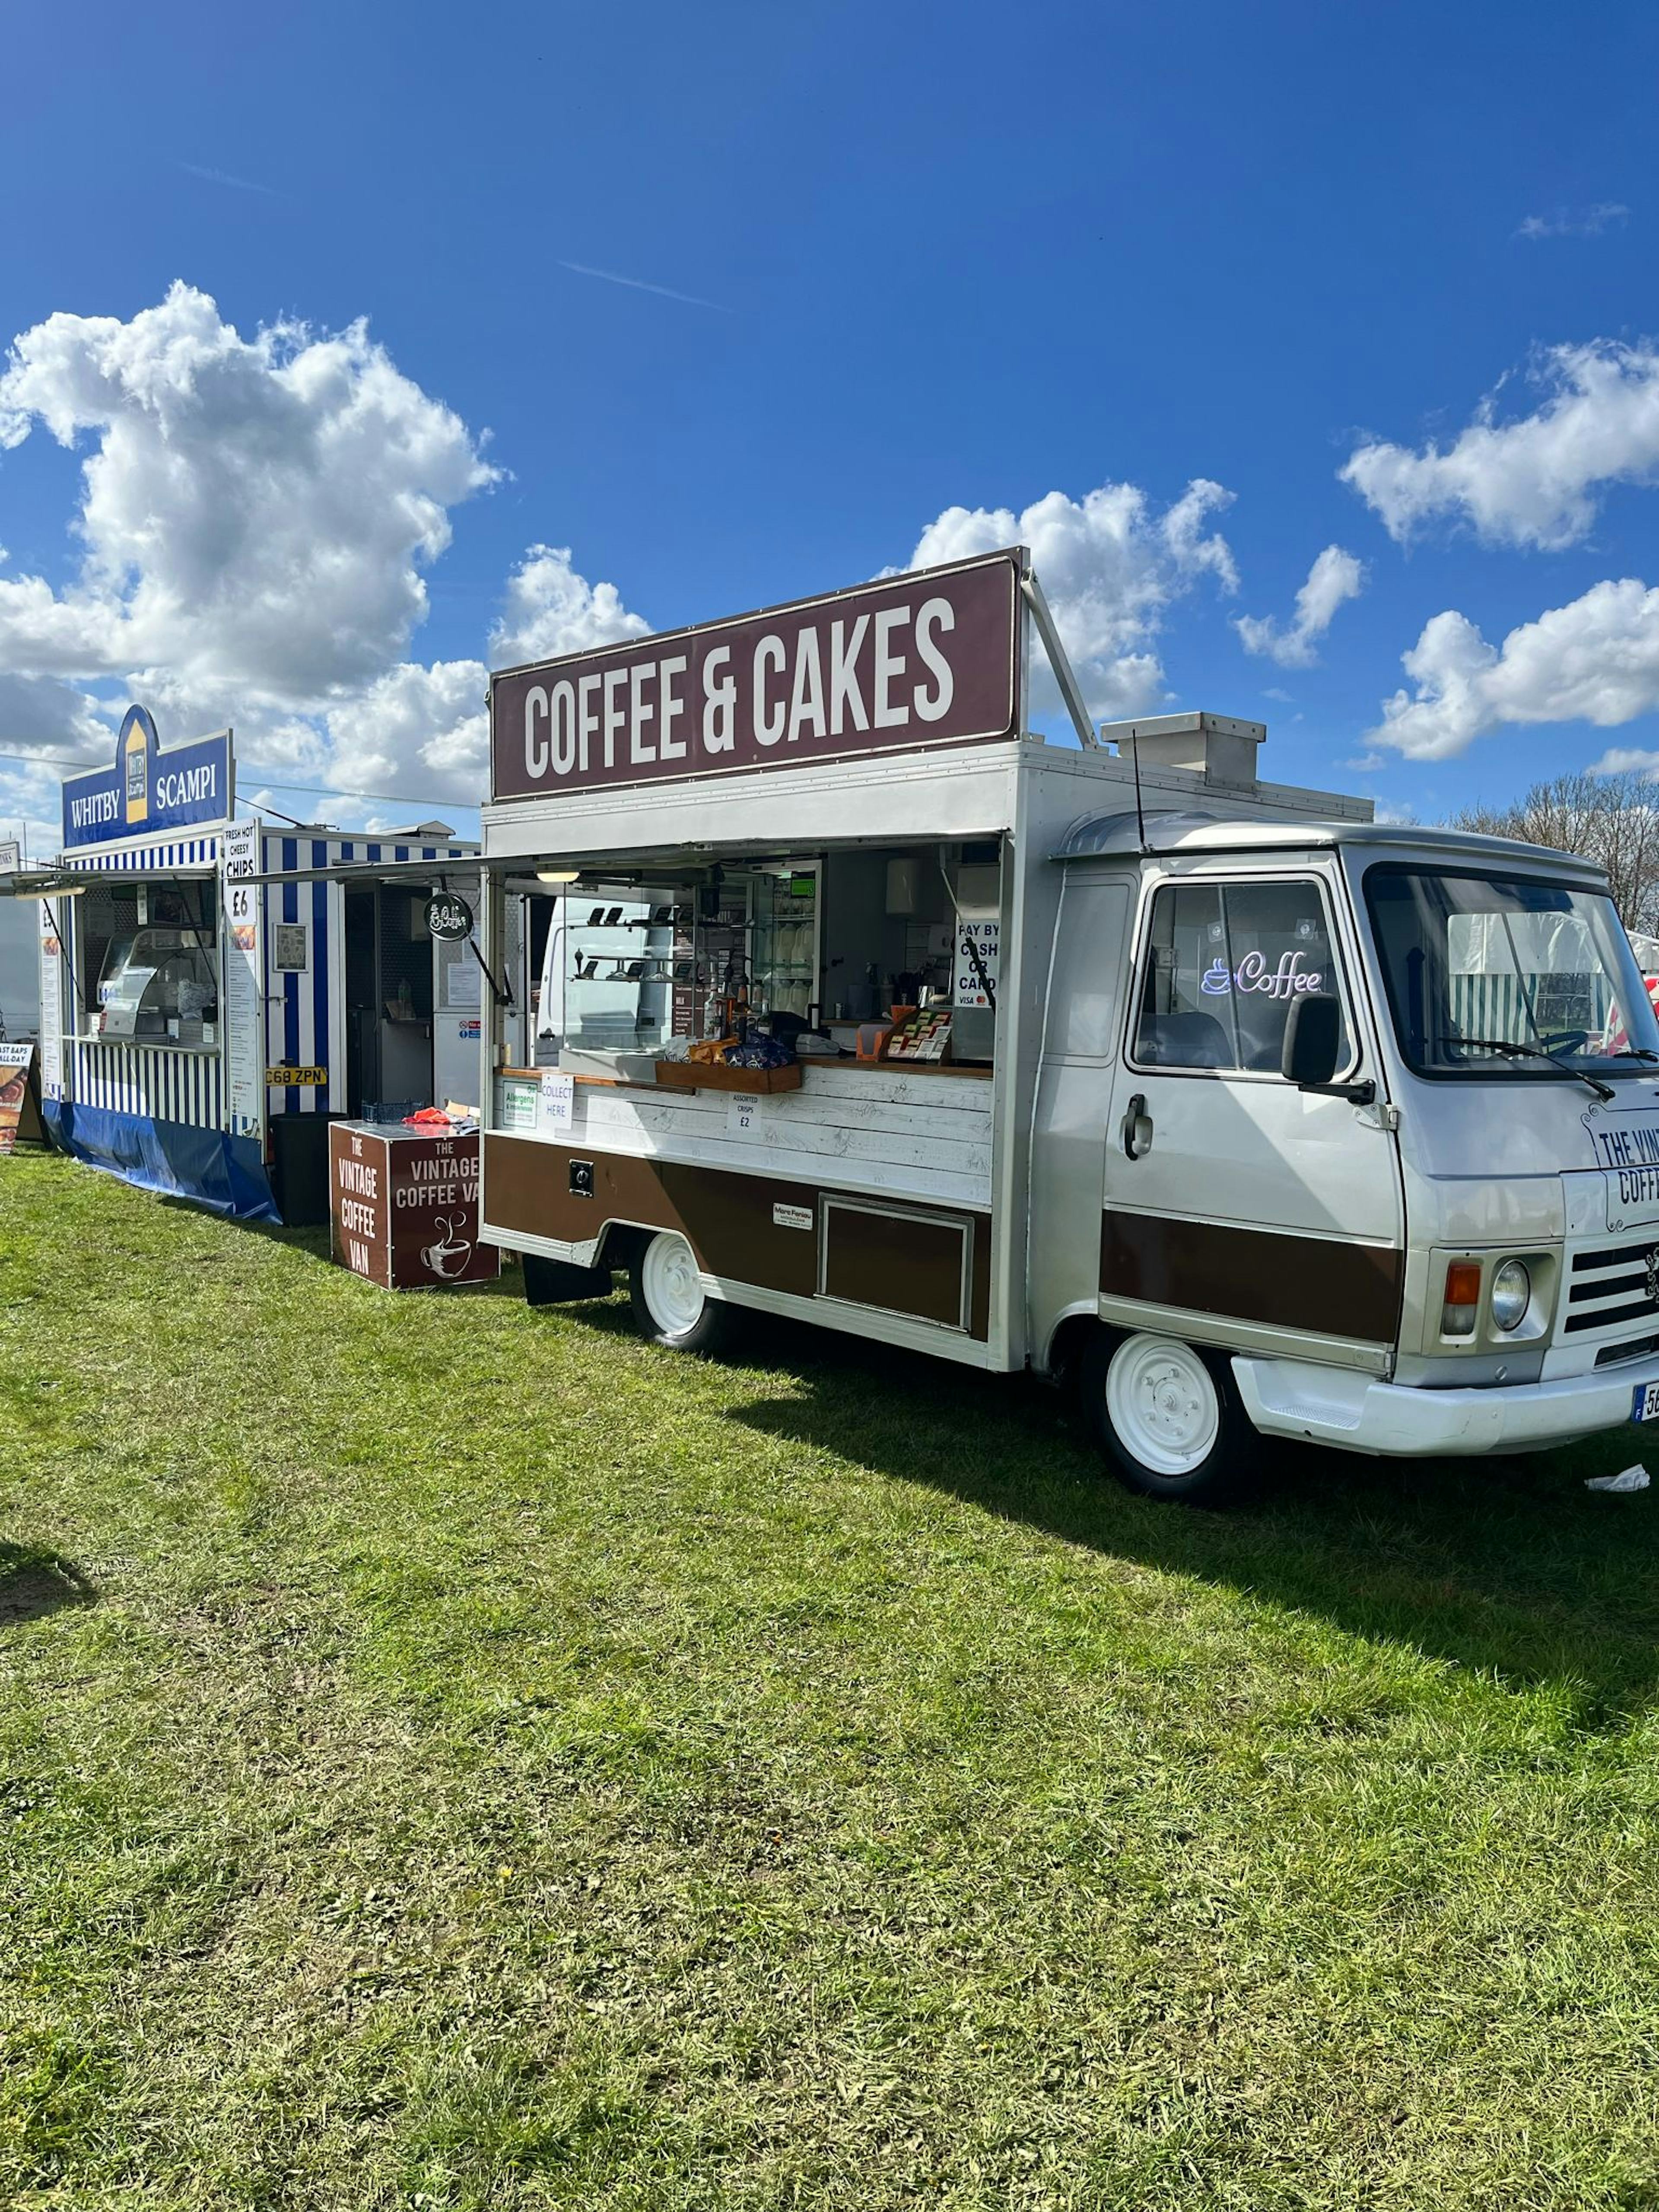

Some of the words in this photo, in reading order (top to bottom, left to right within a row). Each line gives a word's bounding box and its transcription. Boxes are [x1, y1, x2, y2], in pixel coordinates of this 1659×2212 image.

[524, 655, 687, 779] COFFEE
[702, 645, 737, 754] &
[752, 597, 955, 747] CAKES
[71, 789, 120, 829] WHITBY
[156, 764, 216, 810] SCAMPI
[225, 828, 241, 841] FRESH
[242, 826, 253, 837] HOT
[230, 843, 249, 855] CHEESY
[226, 858, 254, 877] CHIPS
[233, 890, 248, 917] £6
[959, 924, 980, 936] PAY
[985, 924, 999, 936] BY
[961, 943, 998, 956] CSH
[1237, 950, 1322, 999] Coffee
[296, 1070, 321, 1082] ZPN
[506, 1093, 534, 1105] Allergens
[542, 1085, 572, 1099] COLLECT
[733, 1095, 758, 1103] ASSORTED
[547, 1104, 566, 1117] HERE
[737, 1105, 753, 1113] CRISPS
[740, 1116, 749, 1127] £2
[352, 1136, 363, 1157] THE
[435, 1142, 454, 1155] THE
[1599, 1131, 1635, 1167] THE
[411, 1157, 479, 1182] VINTAGE
[338, 1157, 378, 1200] VINTAGE
[396, 1184, 457, 1208] COFFEE
[341, 1197, 376, 1239] COFFEE
[349, 1238, 369, 1275] VAN
